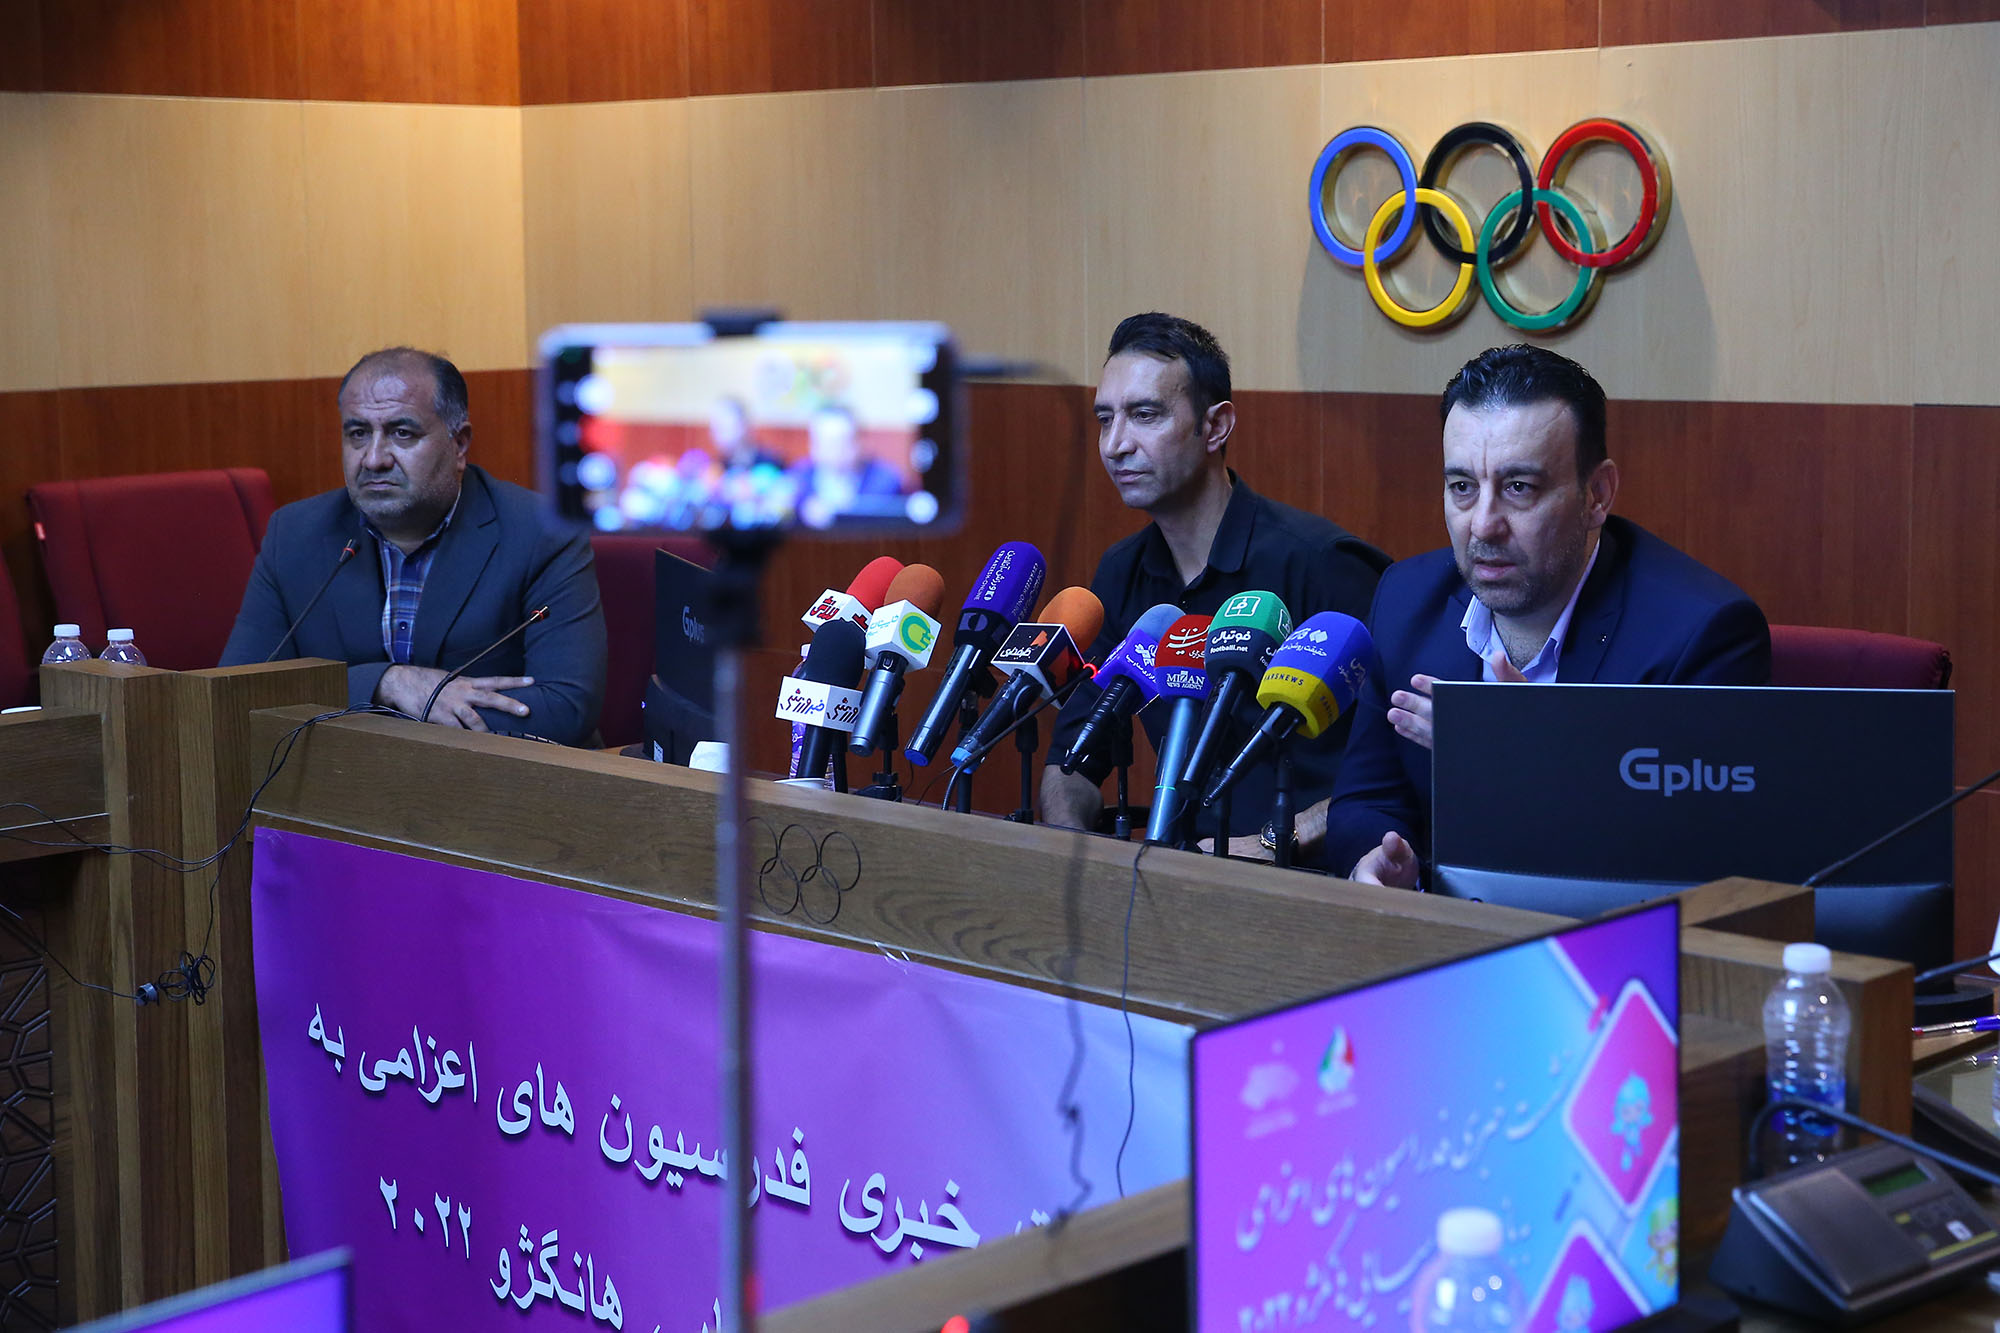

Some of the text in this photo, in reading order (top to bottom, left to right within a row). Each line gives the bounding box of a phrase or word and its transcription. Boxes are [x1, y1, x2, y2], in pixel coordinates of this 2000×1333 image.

[682, 605, 705, 644] Gplus
[1211, 630, 1252, 644] فوتبالی
[1166, 670, 1205, 685] MIZAN
[1618, 747, 1757, 798] Gplus
[307, 1003, 981, 1261] خبری فدرسیون های اعزامی به
[379, 1175, 624, 1331] هانگژو ۲۰۲۲
